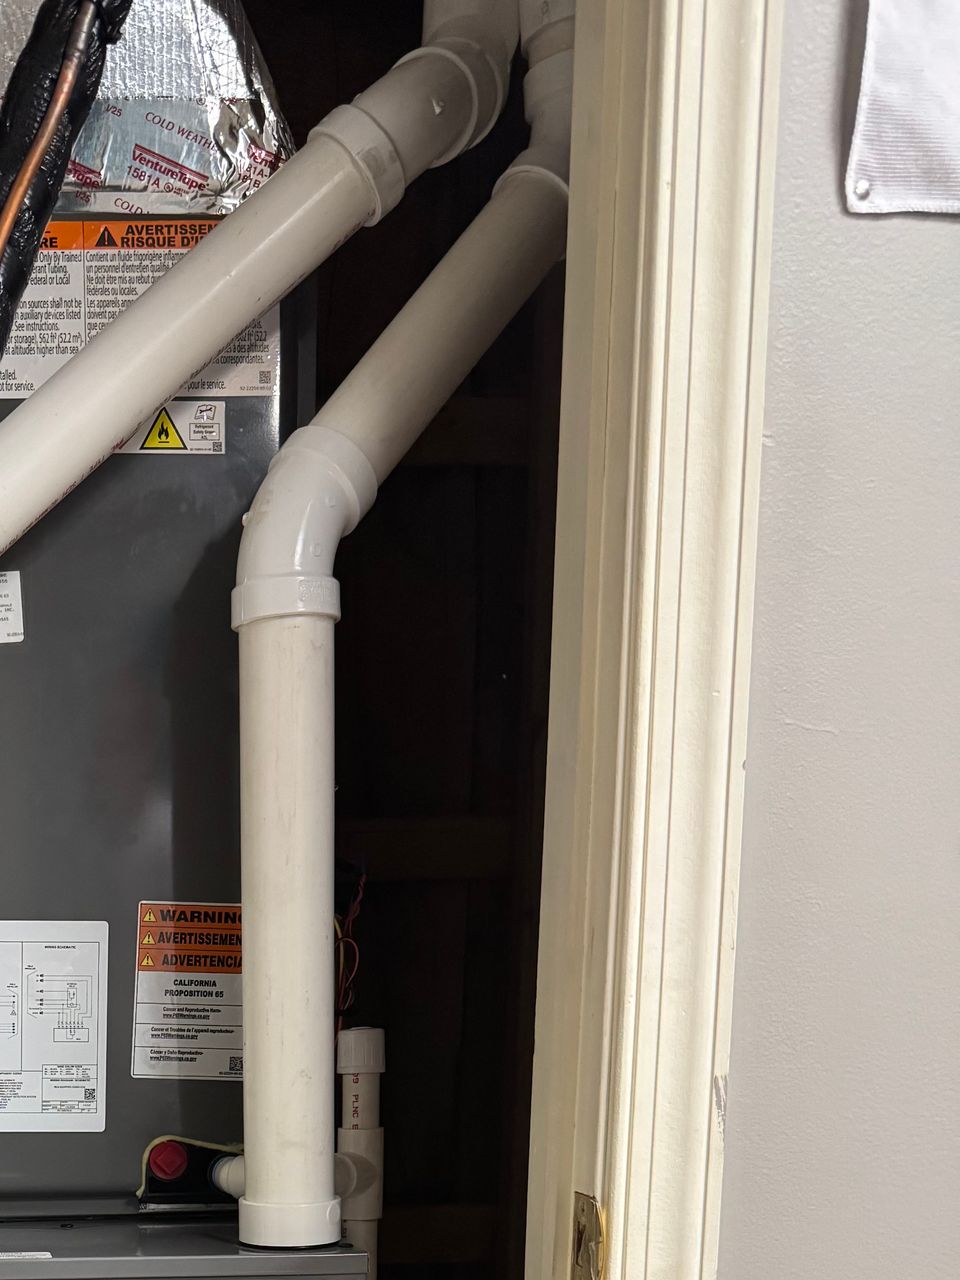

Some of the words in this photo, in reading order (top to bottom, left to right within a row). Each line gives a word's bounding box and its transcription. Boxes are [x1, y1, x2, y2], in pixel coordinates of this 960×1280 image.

[145, 111, 175, 132] COLD
[127, 165, 160, 189] 1581A
[131, 150, 209, 192] VentureTape
[125, 224, 218, 236] AVERTISSEM
[121, 236, 176, 249] RISQUE
[54, 251, 61, 265] By
[61, 251, 82, 262] Trained
[86, 251, 109, 262] Contient
[118, 250, 133, 262] fluide
[86, 265, 93, 273] un
[94, 264, 121, 275] personnel
[121, 262, 149, 273] d'entretien
[29, 274, 47, 285] ederal
[48, 277, 55, 285] or
[55, 274, 71, 285] Local
[86, 275, 94, 285] Ne
[95, 274, 105, 285] doit
[118, 275, 127, 285] mis
[128, 277, 135, 285] au
[136, 274, 151, 284] rebut
[86, 286, 110, 296] fédérales
[111, 287, 119, 296] ou
[28, 300, 49, 309] sources
[50, 298, 63, 309] shall
[63, 298, 74, 309] not
[74, 297, 82, 309] be
[87, 297, 96, 308] Les
[96, 297, 120, 310] appareils
[20, 310, 43, 322] auxiliary
[44, 309, 65, 320] devices
[66, 309, 81, 320] listed
[87, 309, 107, 320] doivent
[14, 321, 25, 331] See
[25, 321, 60, 331] instructions.
[87, 321, 98, 331] que
[39, 332, 50, 344] 562
[11, 346, 35, 355] altitudes
[36, 346, 55, 358] higher
[55, 345, 69, 355] than
[69, 347, 79, 355] sea
[5, 380, 14, 392] for
[160, 909, 242, 924] WARNIN
[157, 931, 242, 946] AVERTISSEMEN
[173, 979, 217, 988] CALIFORNIA
[164, 989, 214, 998] PROPOSITION
[214, 990, 224, 998] 65
[352, 1094, 360, 1119] PLNC
